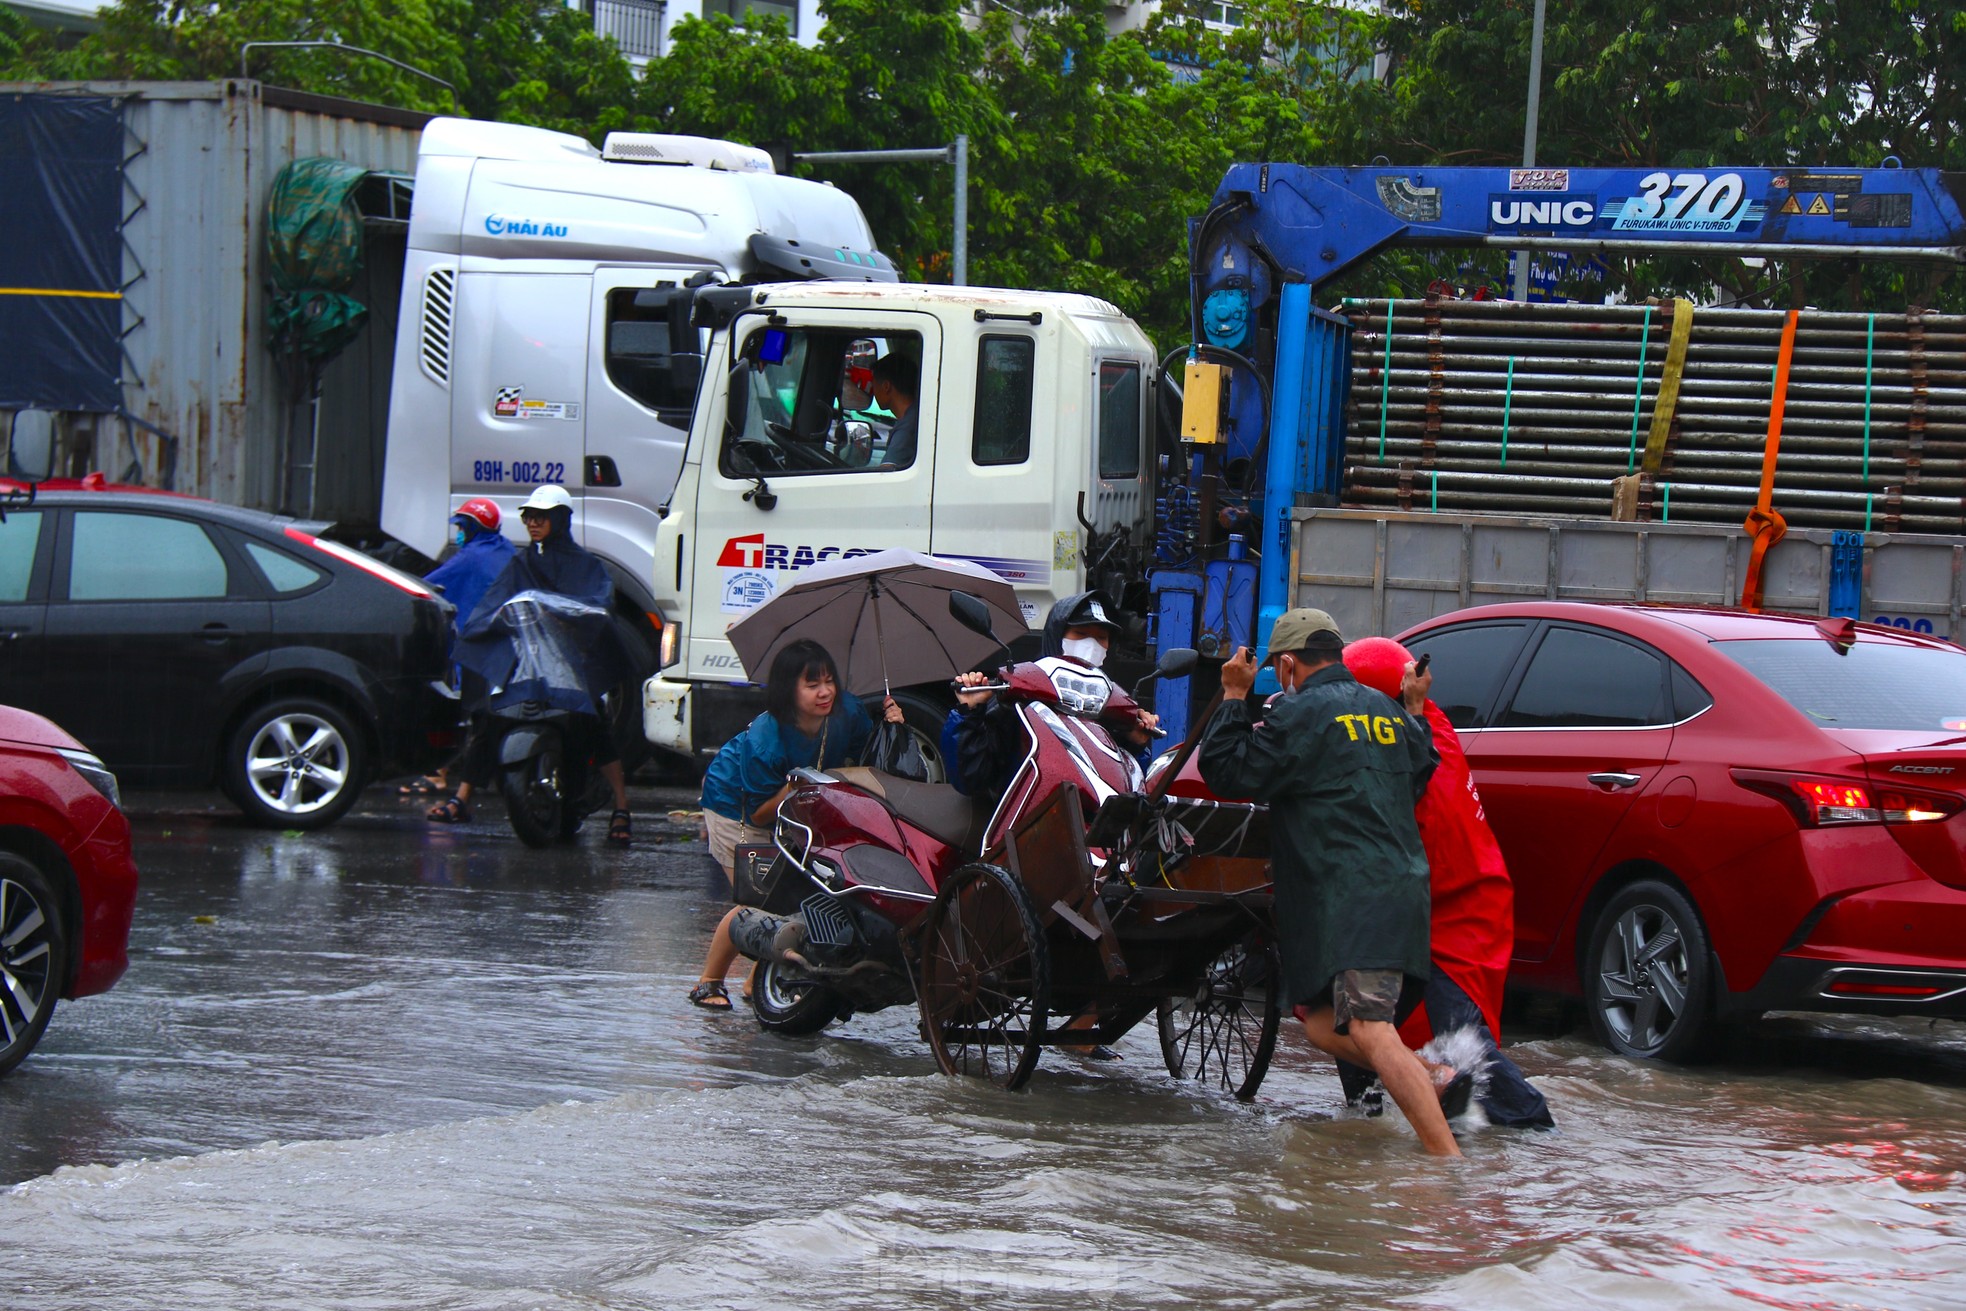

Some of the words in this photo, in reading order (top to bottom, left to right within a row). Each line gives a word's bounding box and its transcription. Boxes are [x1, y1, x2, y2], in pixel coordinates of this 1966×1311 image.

[1629, 172, 1746, 220] 370
[1491, 201, 1594, 225] UNIC
[507, 219, 539, 236] HẢI
[541, 223, 568, 237] ÂU
[1620, 219, 1668, 229] FURUKAWA
[1669, 221, 1692, 230] UNIC
[1693, 221, 1731, 231] V-TURBO
[473, 460, 565, 484] 89H-002.22
[1889, 765, 1955, 774] ACCENT
